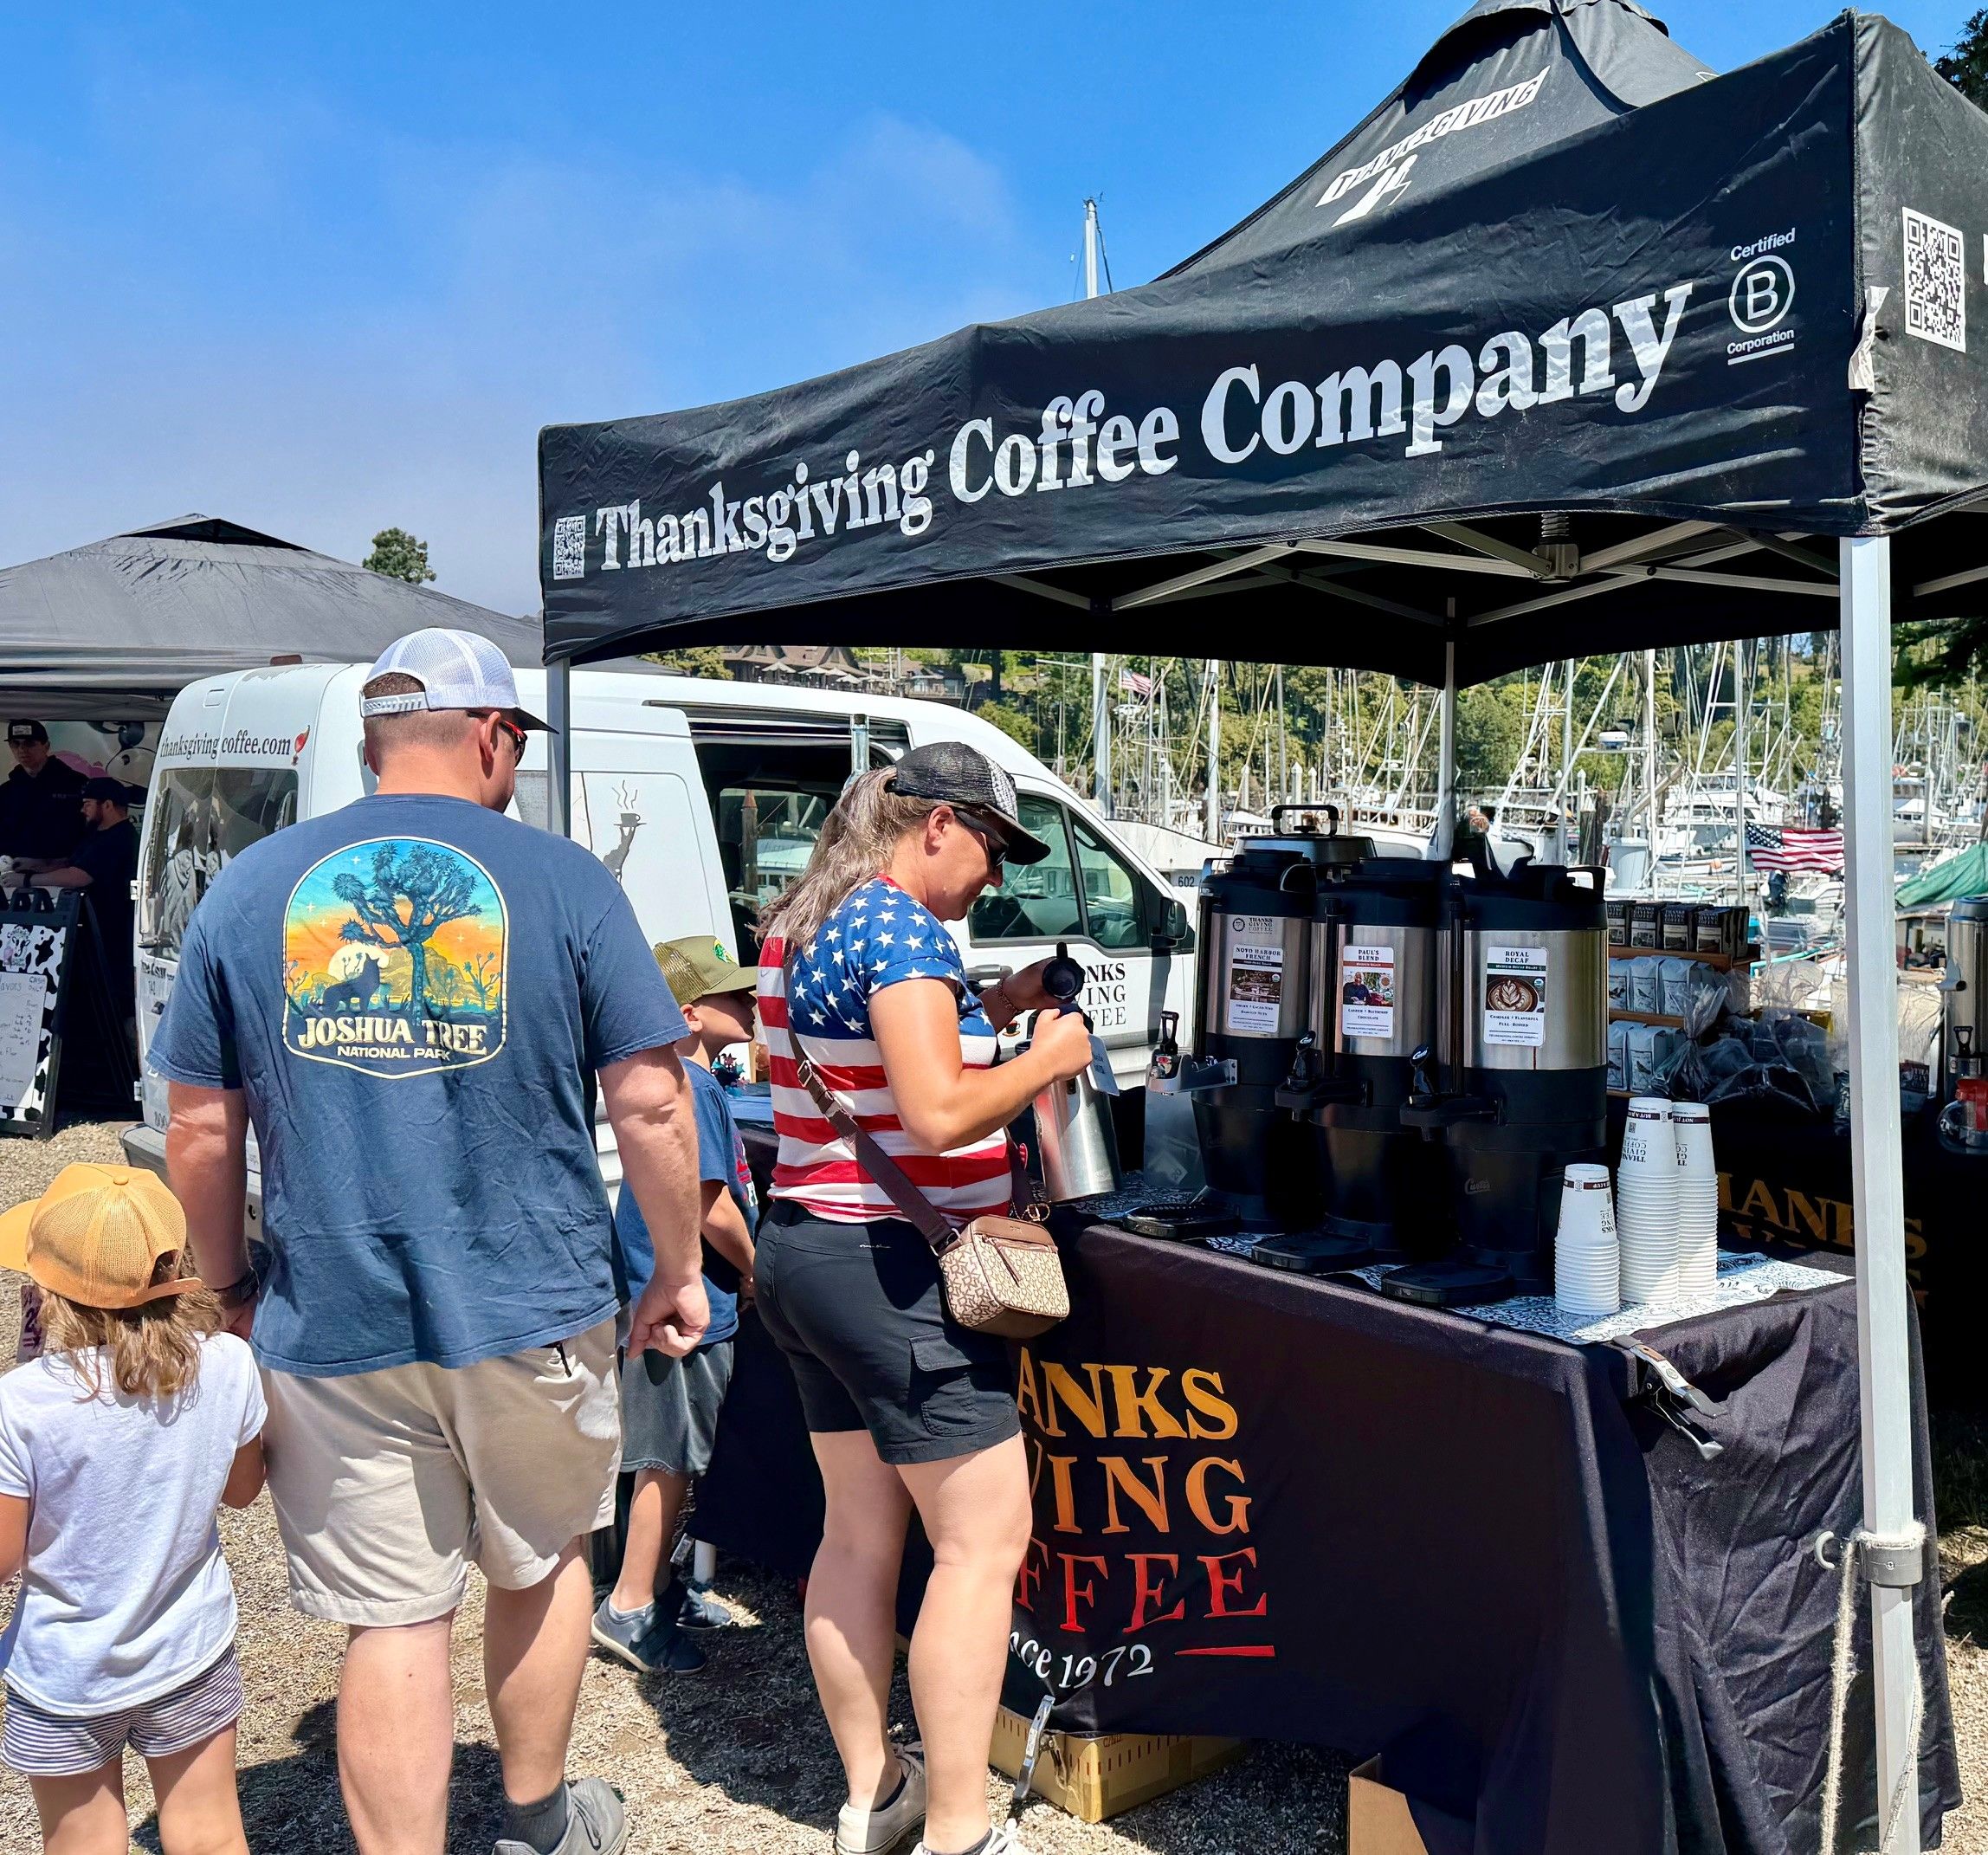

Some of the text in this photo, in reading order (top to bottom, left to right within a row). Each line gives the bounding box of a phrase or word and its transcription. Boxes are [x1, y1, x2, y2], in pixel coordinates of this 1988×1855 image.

[1731, 228, 1796, 262] Certified
[1746, 270, 1778, 320] B
[1727, 329, 1794, 355] Corporation
[594, 282, 1694, 570] Thanksgiving Coffee Company
[1178, 876, 1194, 888] 602
[298, 1017, 487, 1056] JOSHUA TREE
[337, 1044, 451, 1061] NATIONAL PARK
[1058, 1644, 1154, 1689] 1972
